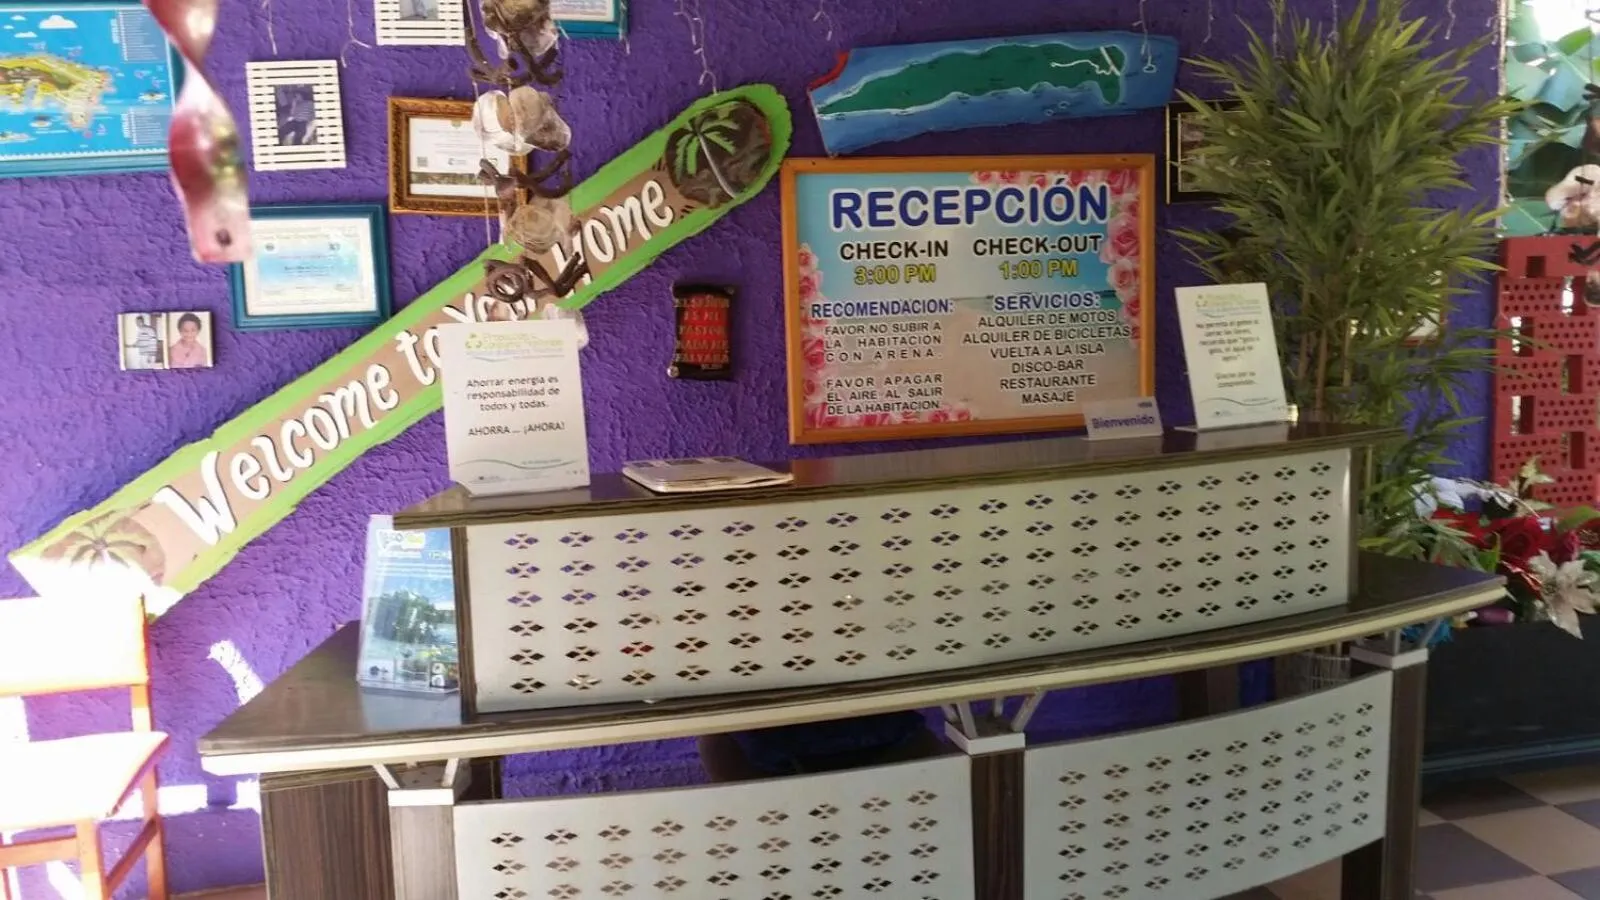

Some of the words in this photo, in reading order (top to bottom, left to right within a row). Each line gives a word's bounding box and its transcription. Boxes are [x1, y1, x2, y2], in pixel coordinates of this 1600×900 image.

[831, 177, 1109, 229] RECEPCIÓN
[839, 240, 950, 261] CHECK-IN
[972, 234, 1103, 256] CHECK-OUT
[853, 264, 900, 286] 3:00
[903, 263, 937, 284] PM
[999, 259, 1043, 281] 1:00
[1046, 258, 1080, 278] PM
[811, 298, 953, 318] RECOMENDACION:
[993, 292, 1101, 312] SERVICIOS:
[978, 314, 1045, 327] ALQUILER
[1049, 313, 1066, 324] DE
[1069, 310, 1116, 323] MOTOS
[824, 324, 865, 336] FAVOR
[869, 323, 888, 334] NO
[891, 322, 929, 333] SUBIR
[932, 322, 942, 331] A
[962, 330, 1030, 344] ALQUILER
[1033, 329, 1051, 341] DE
[1054, 325, 1131, 341] BICICLETAS
[825, 340, 842, 349] LA
[858, 335, 942, 348] HABITACION
[826, 352, 862, 362] CON
[990, 345, 1040, 359] VUELTA
[1043, 345, 1052, 355] A
[1056, 344, 1073, 356] LA
[1075, 343, 1104, 354] ISLA
[1011, 359, 1084, 374] DISCO-BAR
[467, 378, 504, 387] Ahorrar
[548, 376, 559, 384] es
[826, 377, 875, 389] FAVOR
[884, 374, 943, 386] APAGAR
[999, 374, 1096, 390] RESTAURANTE
[467, 388, 545, 401] responsabilidad
[547, 387, 560, 396] de
[826, 392, 842, 402] EL
[849, 390, 877, 400] AIRE
[885, 389, 901, 399] AL
[907, 387, 943, 398] SALIR
[1021, 390, 1076, 404] MASAJE
[480, 402, 508, 411] todos
[510, 403, 516, 412] y
[827, 405, 844, 415] DE
[847, 405, 862, 414] LA
[865, 400, 940, 413] HABITACION
[152, 363, 399, 546] Welcome
